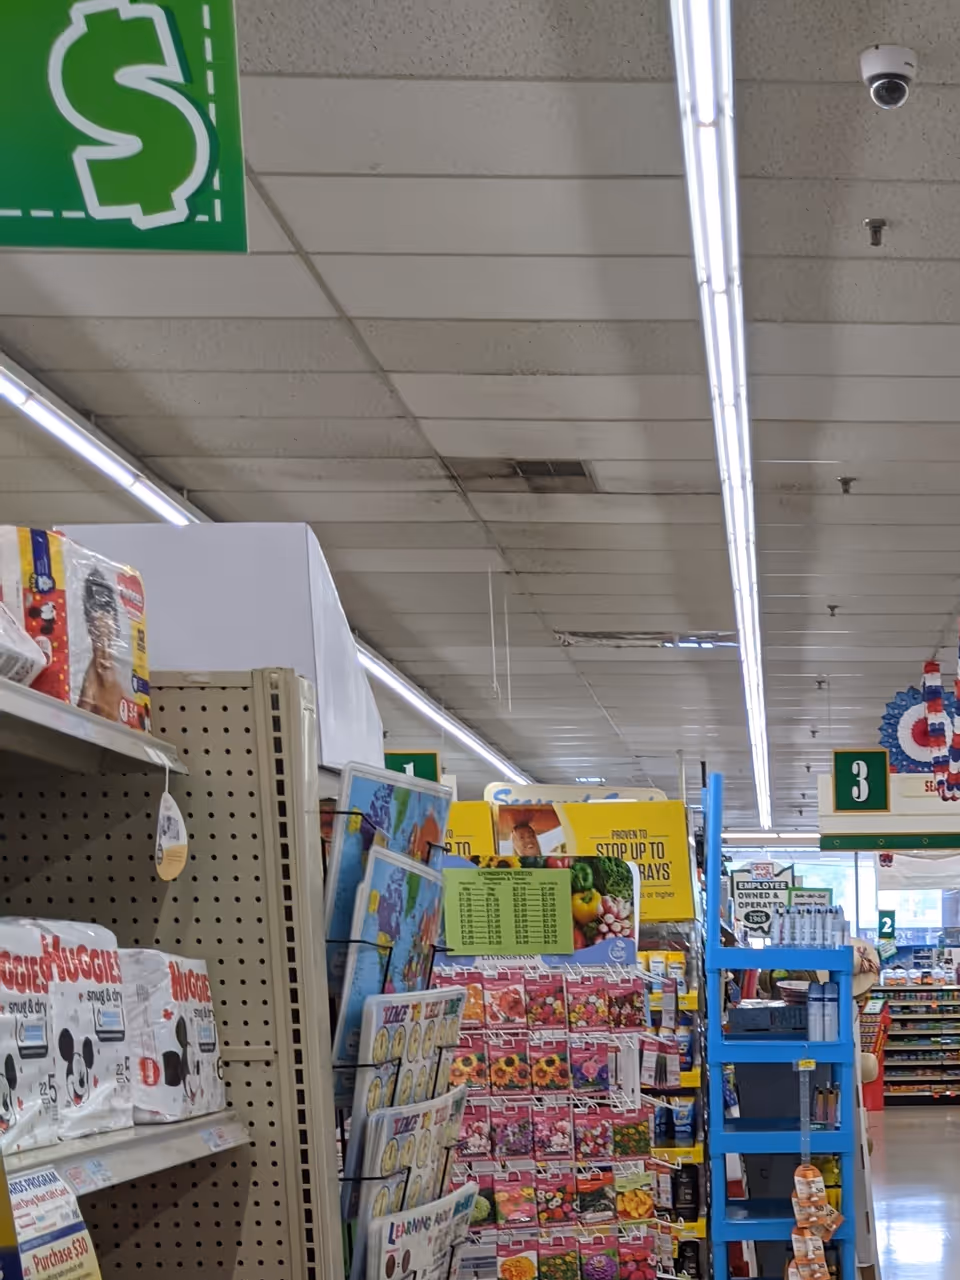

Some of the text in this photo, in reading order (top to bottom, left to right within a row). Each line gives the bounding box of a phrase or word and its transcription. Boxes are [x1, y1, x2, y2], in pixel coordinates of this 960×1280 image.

[851, 760, 870, 802] 3
[611, 829, 648, 840] PROVEN TO
[596, 841, 665, 860] STOP UP TO
[753, 863, 770, 872] drug
[655, 891, 675, 900] higher
[881, 917, 893, 933] 2
[481, 953, 537, 961] LIVINGSTON
[168, 960, 211, 1003] HUGGIE
[87, 989, 105, 1006] snug
[106, 988, 111, 1001] &
[8, 997, 47, 1019] snug & dry
[39, 1073, 58, 1104] 22 5
[24, 1170, 60, 1192] PROGRAM
[20, 1196, 39, 1209] Drug
[33, 1192, 48, 1206] Mart
[387, 1215, 432, 1246] LEARNING
[32, 1237, 89, 1274] Purchase $30
